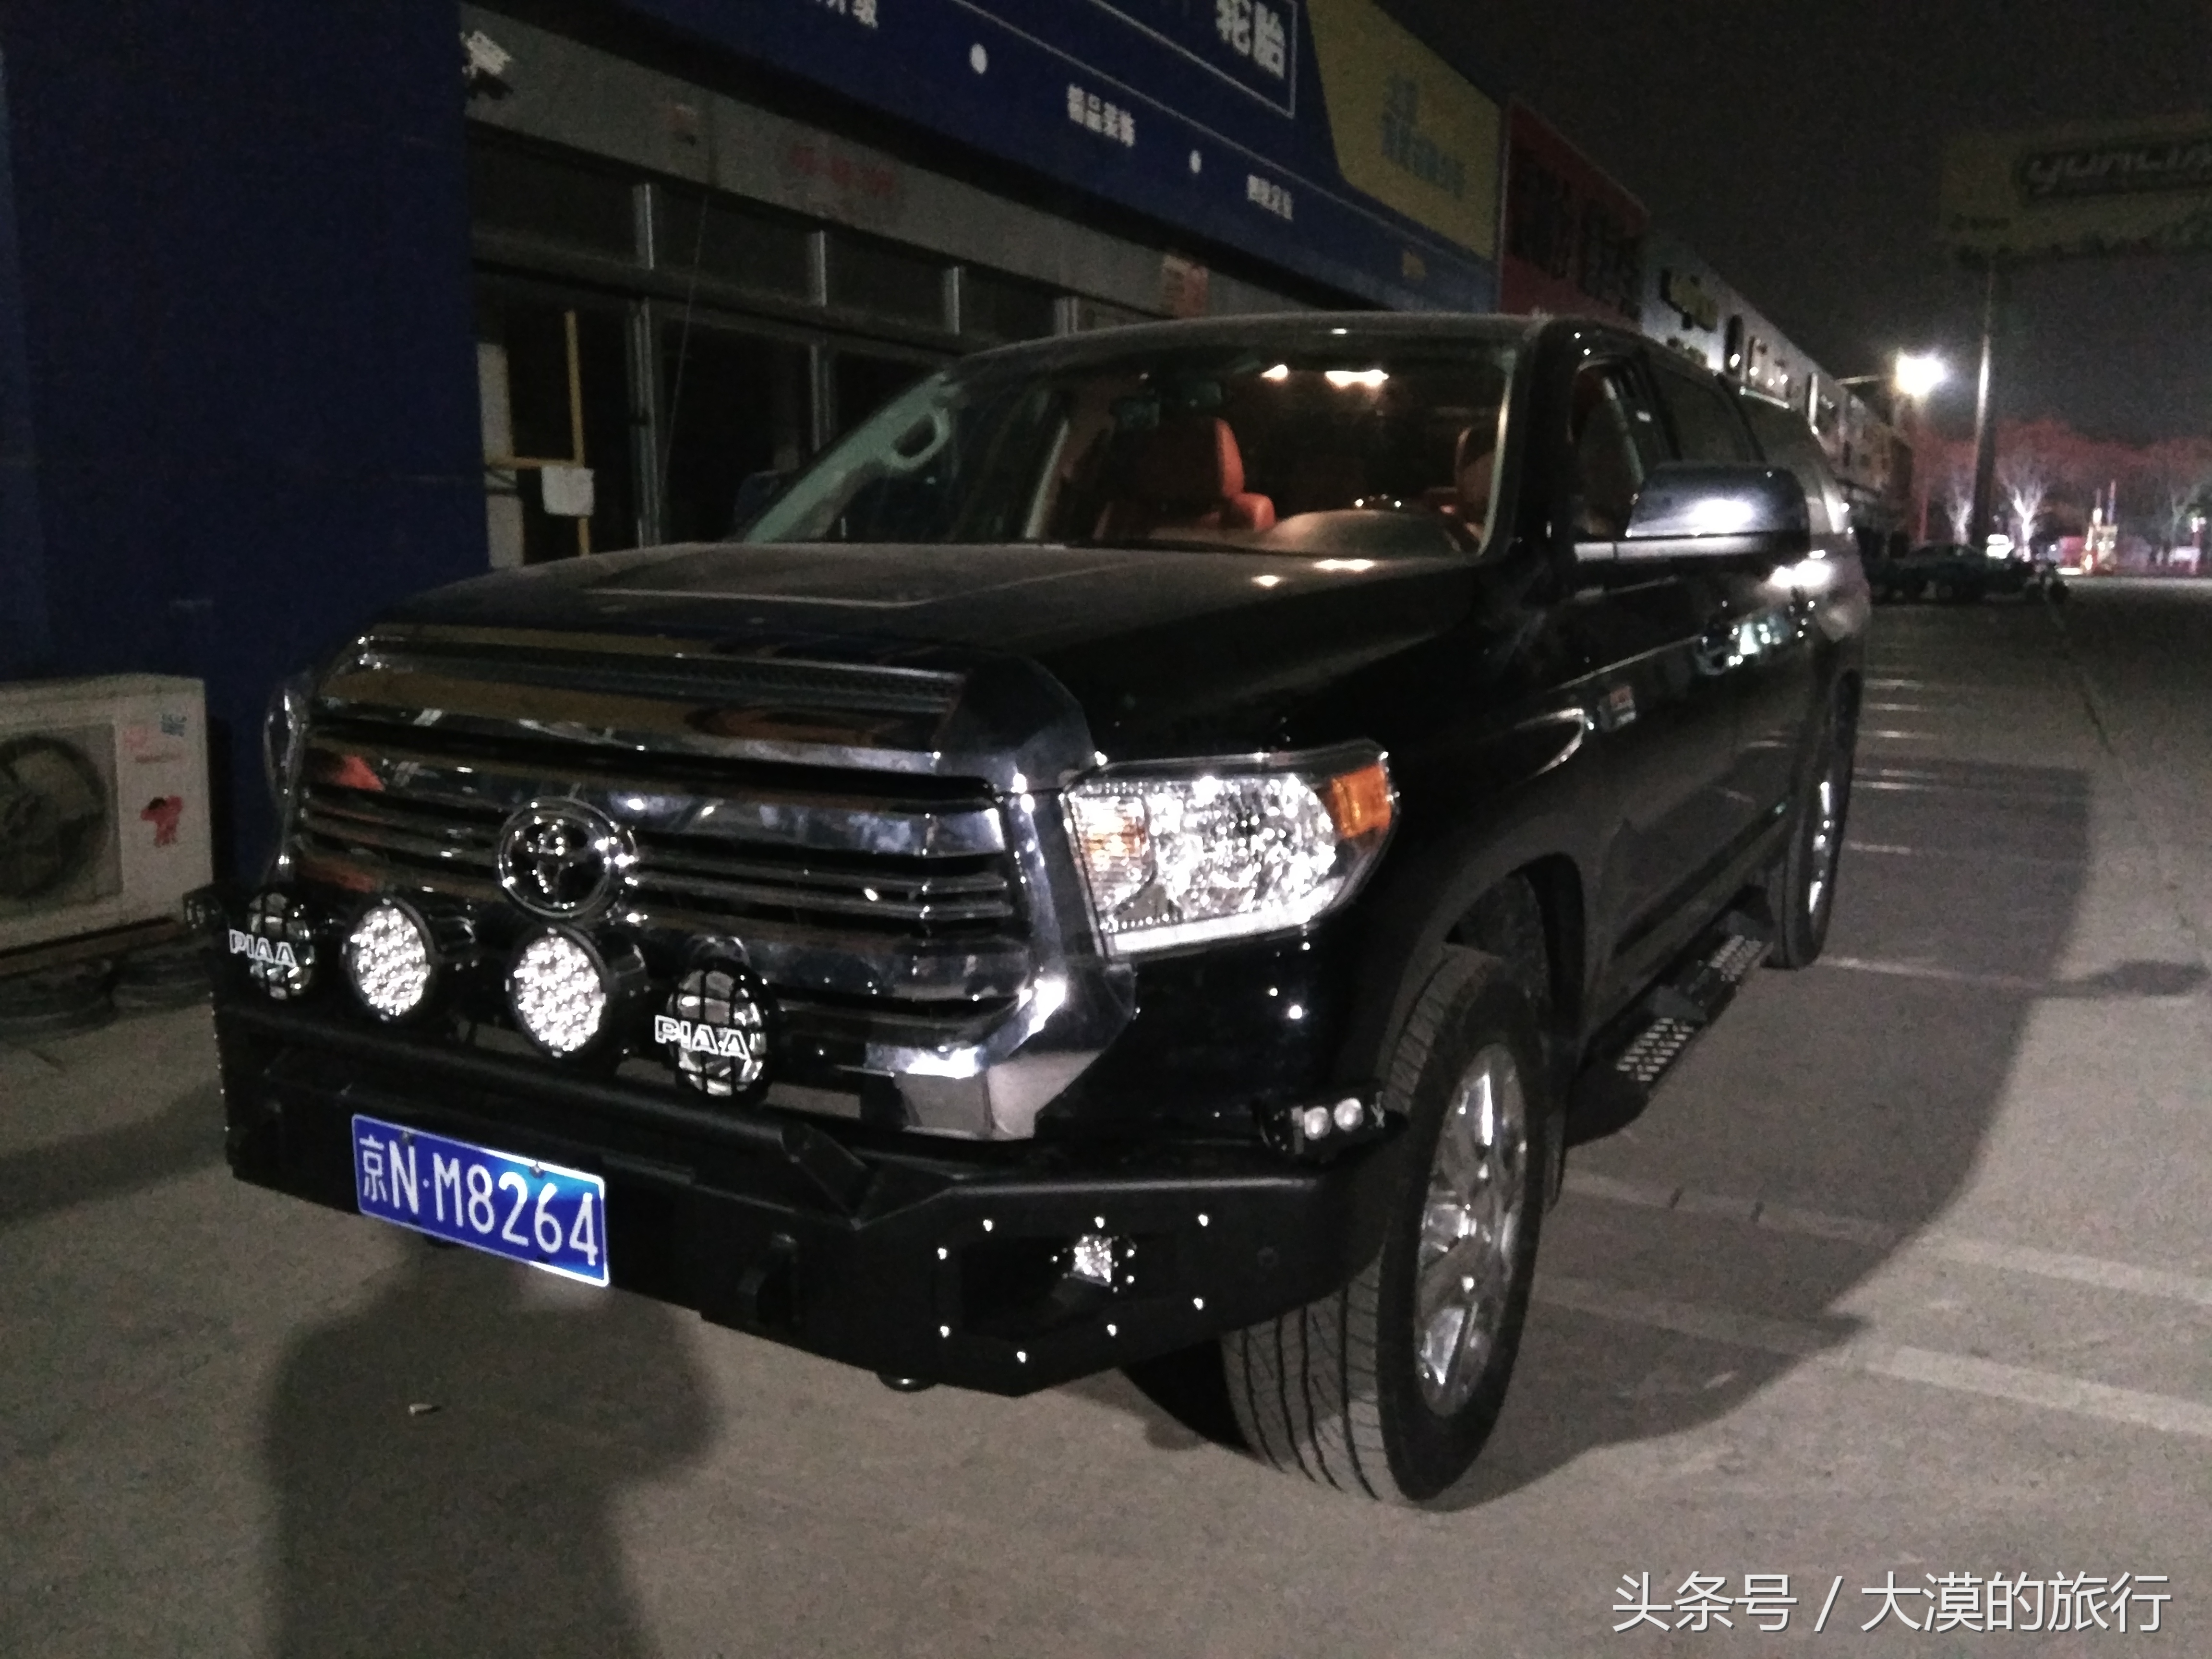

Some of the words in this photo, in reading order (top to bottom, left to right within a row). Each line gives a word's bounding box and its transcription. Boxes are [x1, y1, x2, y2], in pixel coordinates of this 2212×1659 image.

[1215, 0, 1285, 78] 轮胎
[229, 928, 297, 968] PIAA
[654, 1014, 750, 1060] PIAA
[359, 1134, 599, 1266] 京N·M8264
